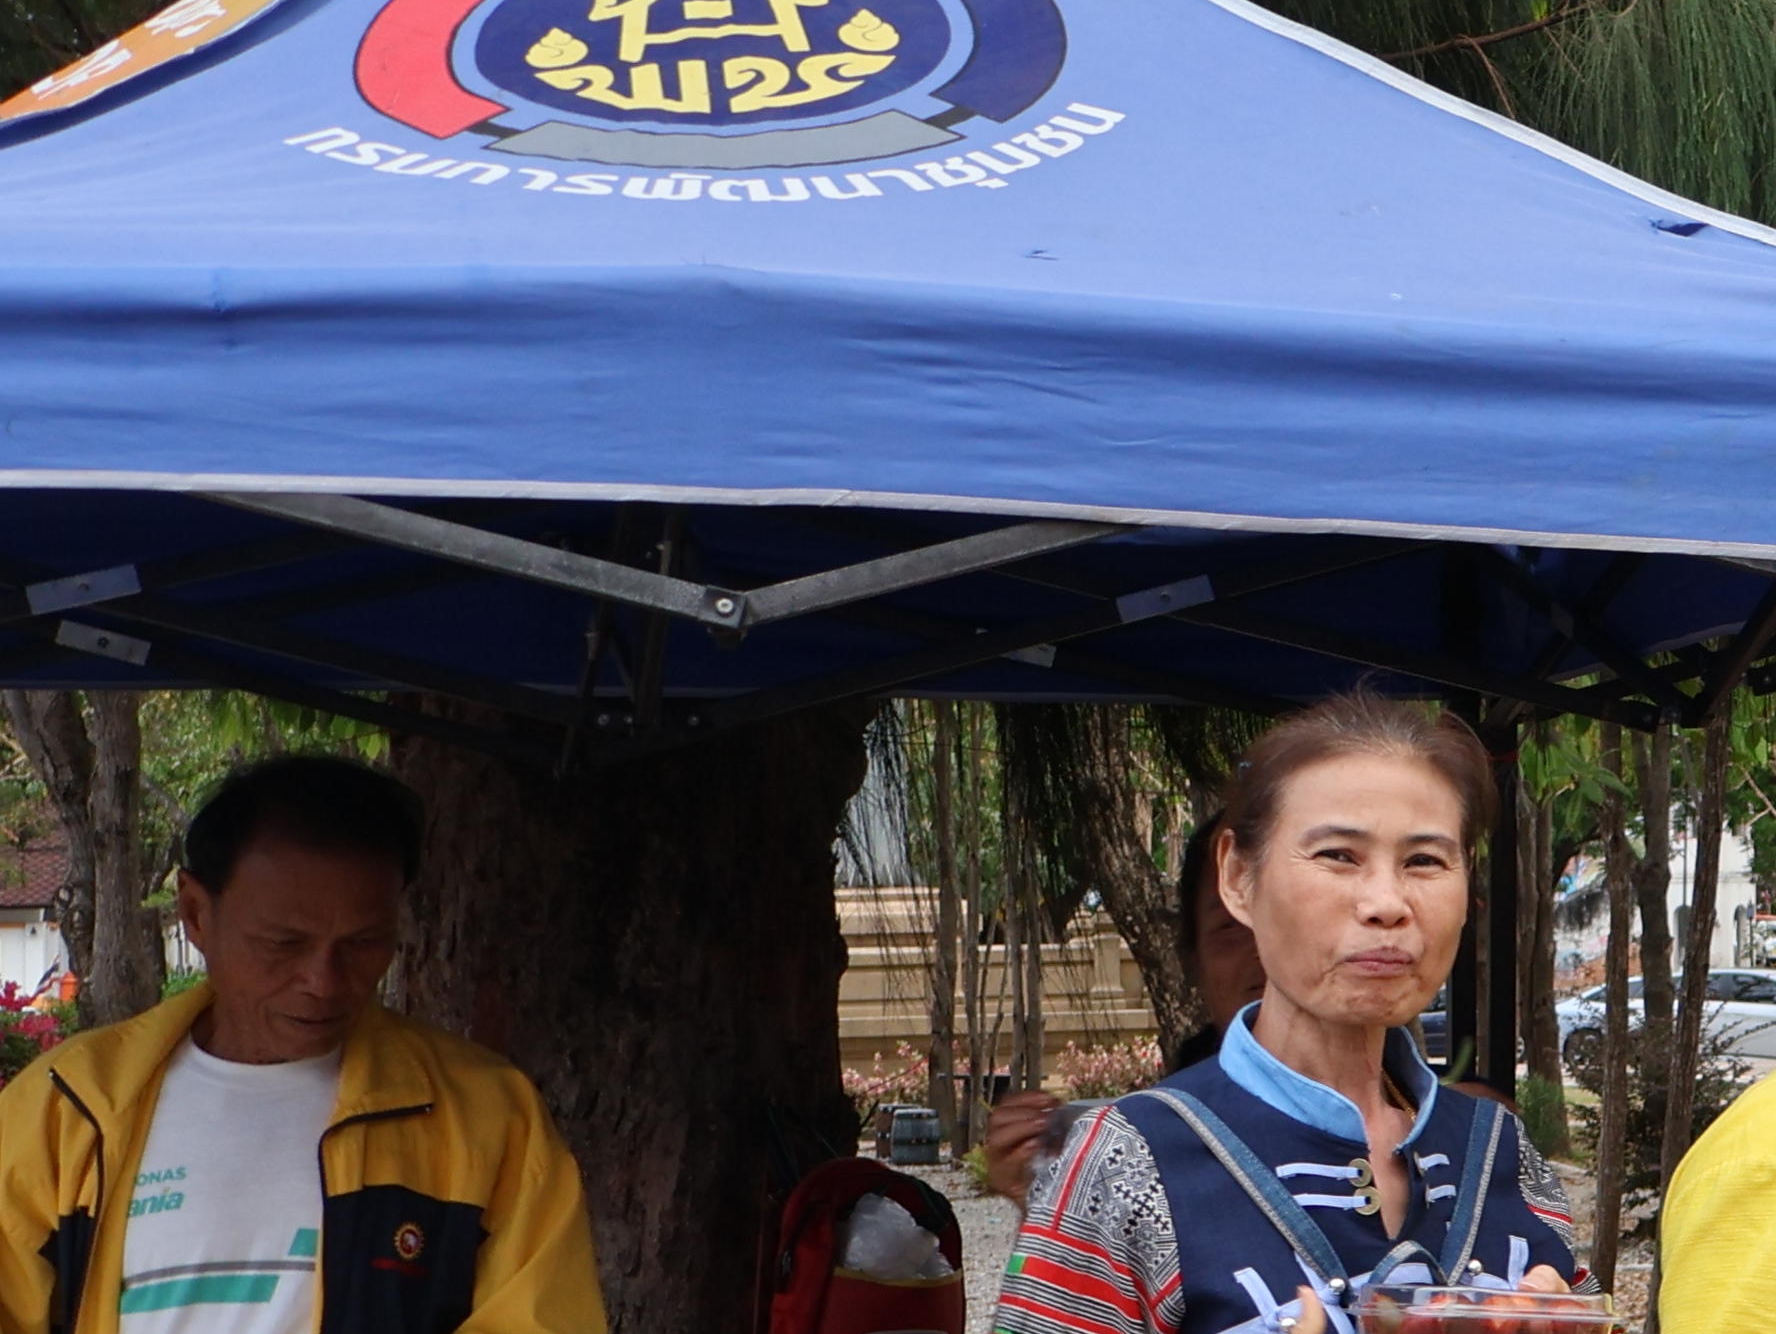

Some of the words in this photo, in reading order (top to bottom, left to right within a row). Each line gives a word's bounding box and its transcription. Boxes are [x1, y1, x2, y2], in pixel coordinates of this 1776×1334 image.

[285, 101, 1128, 204] กรมการพัฒนาชุมชน
[136, 1166, 187, 1187] ONAS
[129, 1187, 184, 1218] ania
